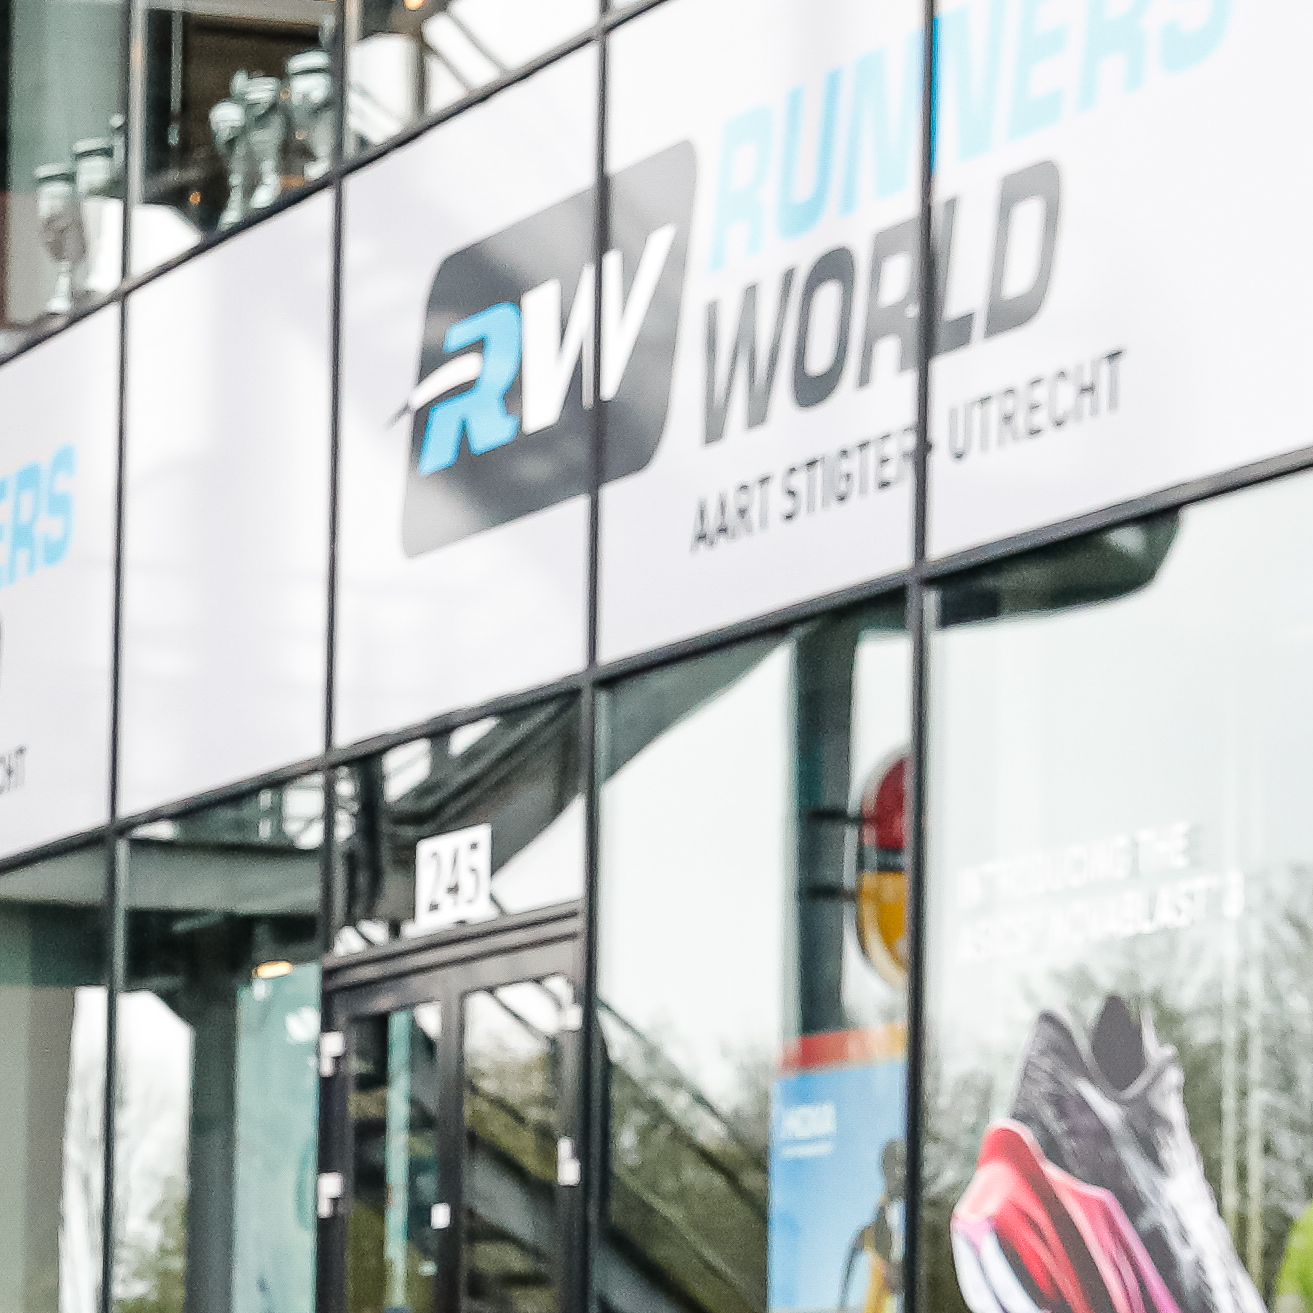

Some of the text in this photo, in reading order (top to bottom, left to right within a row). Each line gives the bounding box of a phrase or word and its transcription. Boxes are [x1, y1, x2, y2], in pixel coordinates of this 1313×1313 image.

[412, 223, 677, 476] RW
[702, 160, 1060, 447] WORLD
[690, 474, 772, 553] AART
[948, 349, 1127, 463] UTRECHT
[427, 842, 481, 912] 245
